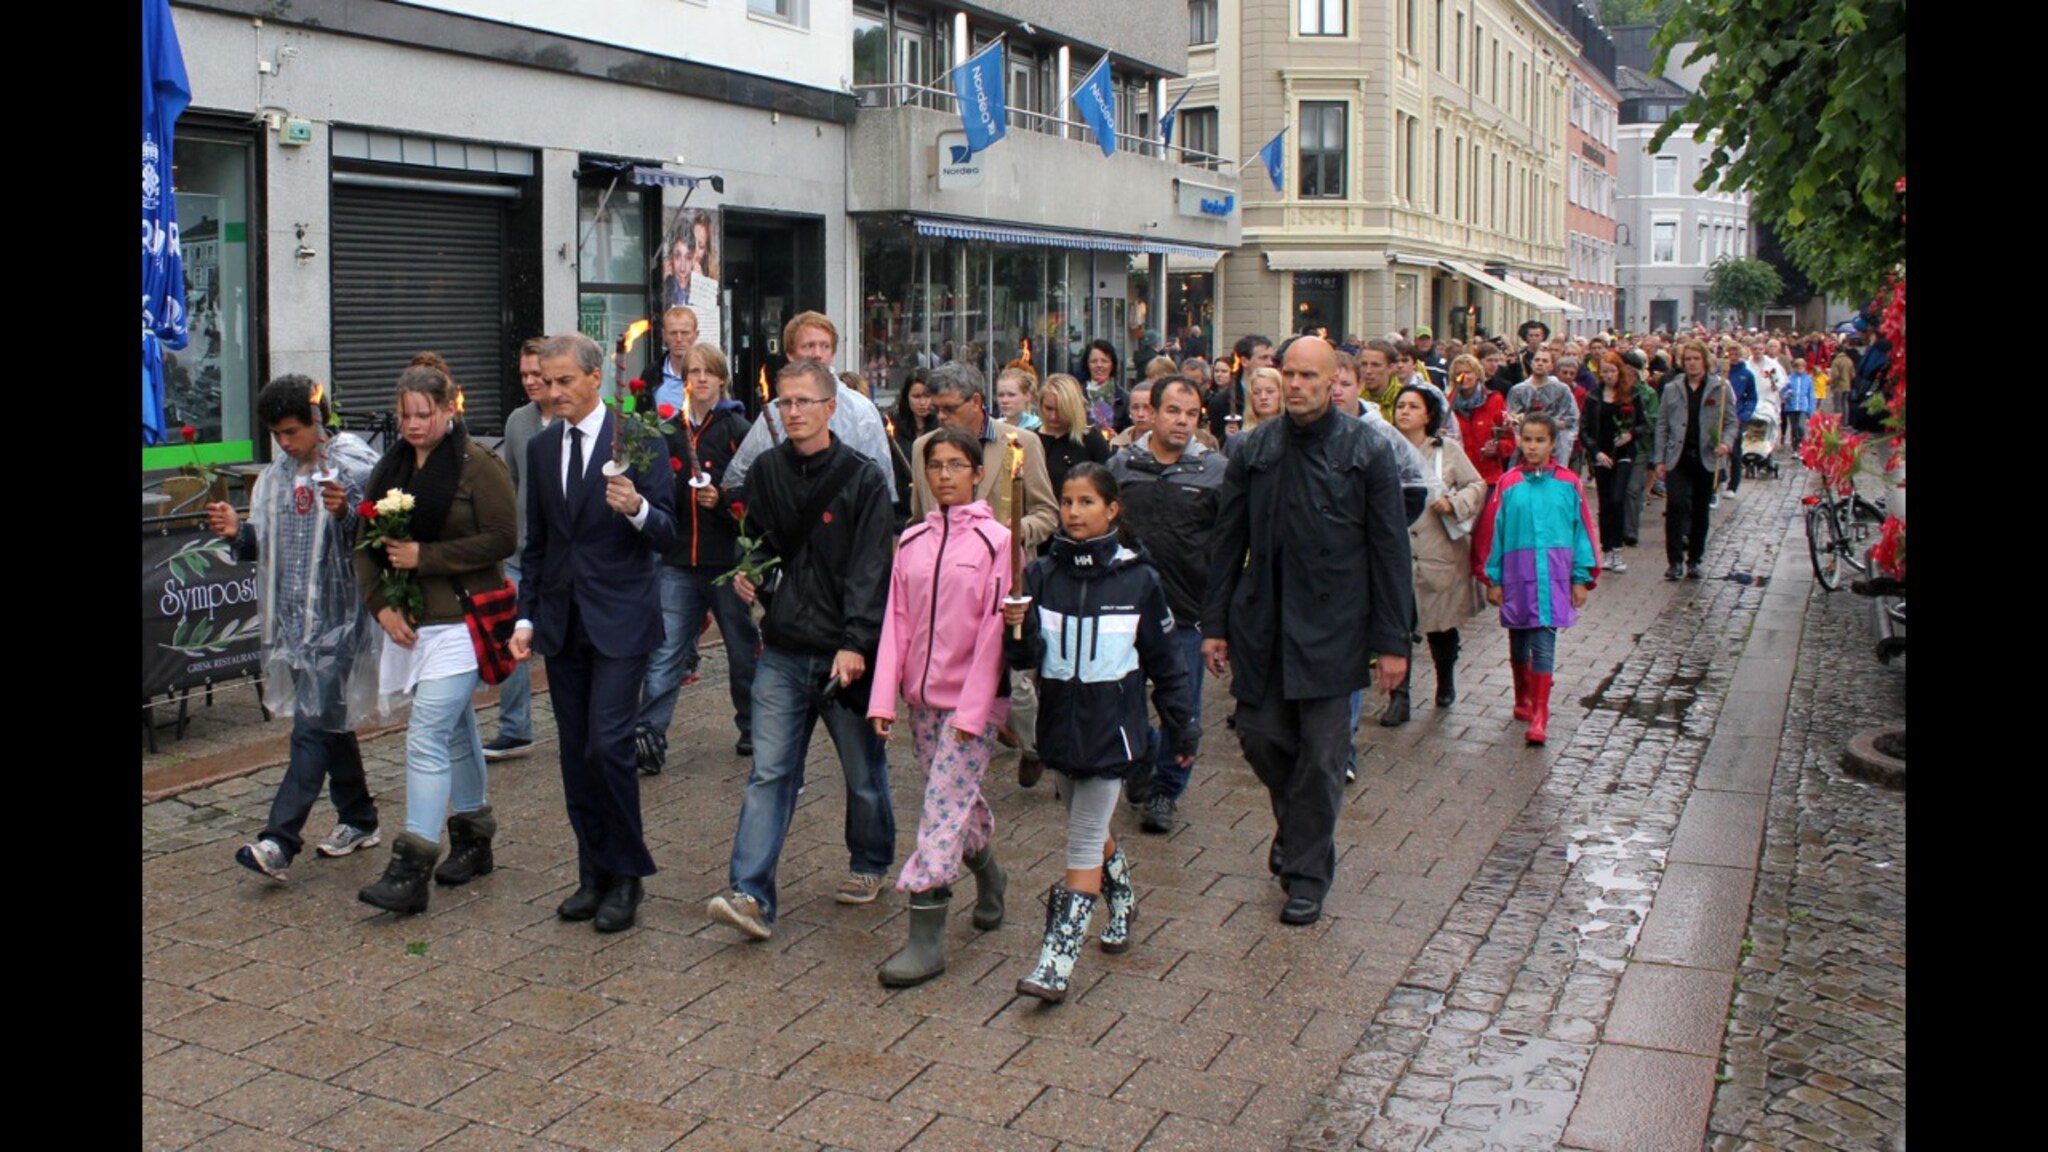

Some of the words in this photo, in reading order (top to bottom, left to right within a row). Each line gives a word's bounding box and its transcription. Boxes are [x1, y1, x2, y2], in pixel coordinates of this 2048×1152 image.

[971, 65, 990, 124] Nordea
[1089, 82, 1114, 129] Nordea
[943, 167, 979, 176] Nordea
[160, 567, 258, 628] Symposi
